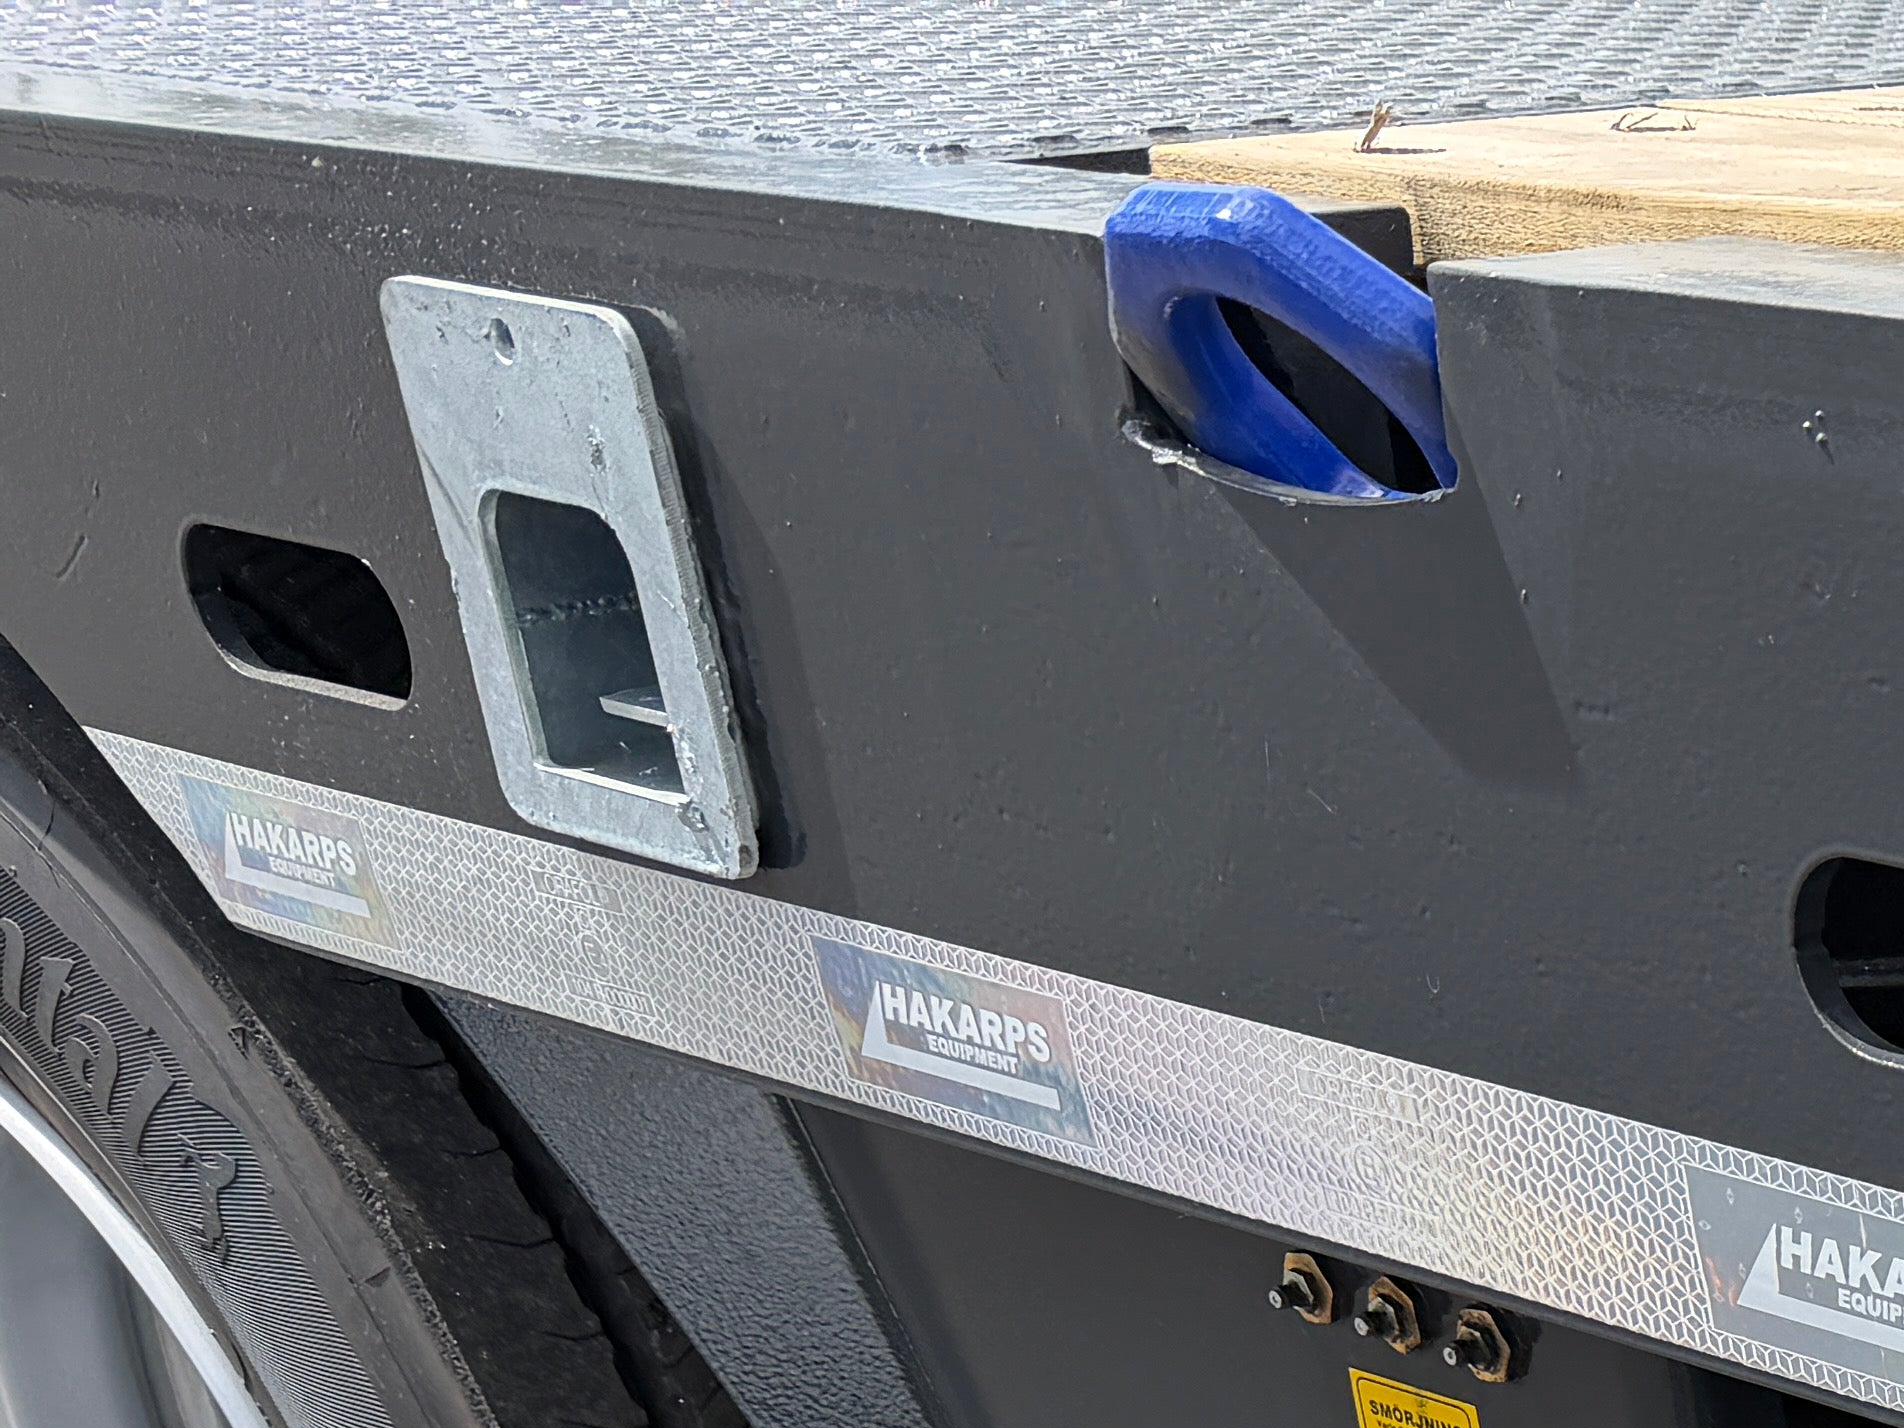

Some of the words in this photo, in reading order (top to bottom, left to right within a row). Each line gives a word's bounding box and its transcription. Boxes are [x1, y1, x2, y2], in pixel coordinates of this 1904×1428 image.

[231, 812, 357, 876] HAKARPS
[268, 856, 335, 887] EQUIPMENT
[882, 982, 1051, 1062] HAKARPS
[926, 1034, 1019, 1074] EQUIPMENT
